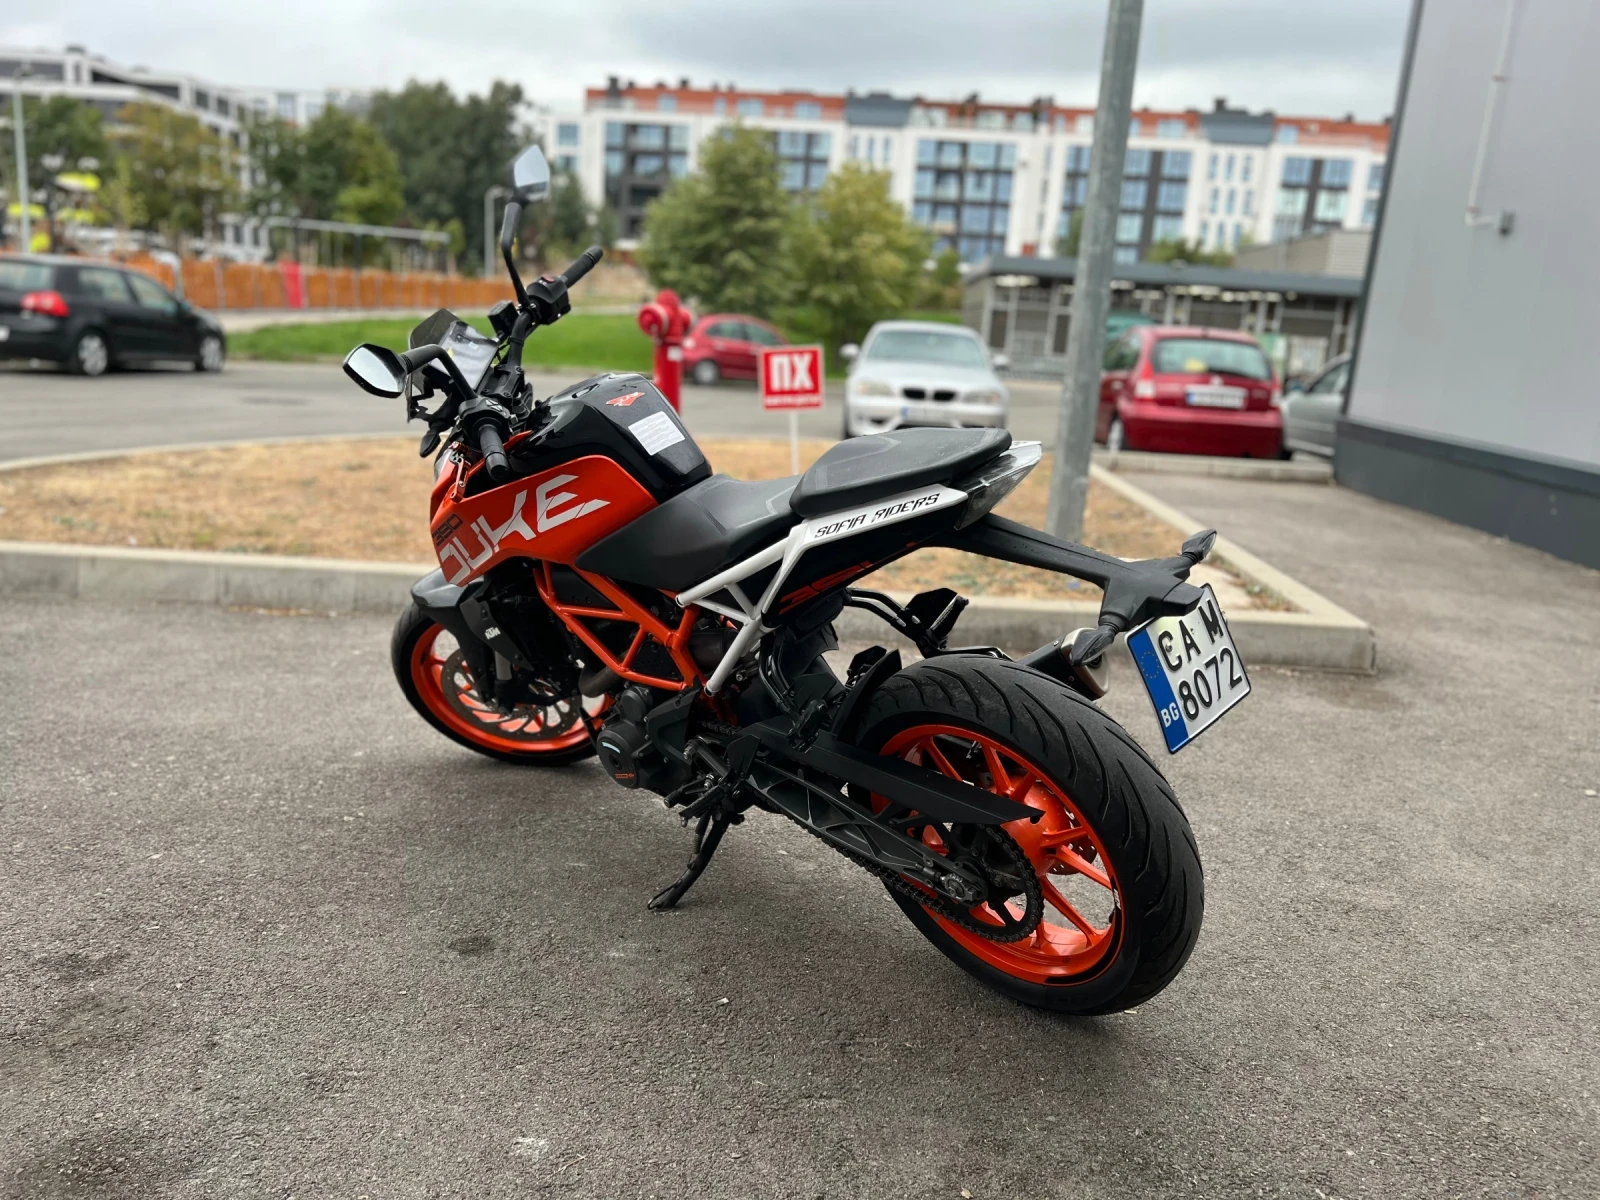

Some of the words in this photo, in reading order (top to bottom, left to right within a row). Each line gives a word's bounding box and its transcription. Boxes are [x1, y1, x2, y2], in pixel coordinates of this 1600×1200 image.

[770, 353, 814, 391] ПХ
[439, 474, 611, 585] DUKE
[814, 514, 867, 538] SOFIA
[871, 493, 941, 523] RIDERS
[1178, 647, 1243, 721] 8072
[1160, 702, 1181, 728] BG
